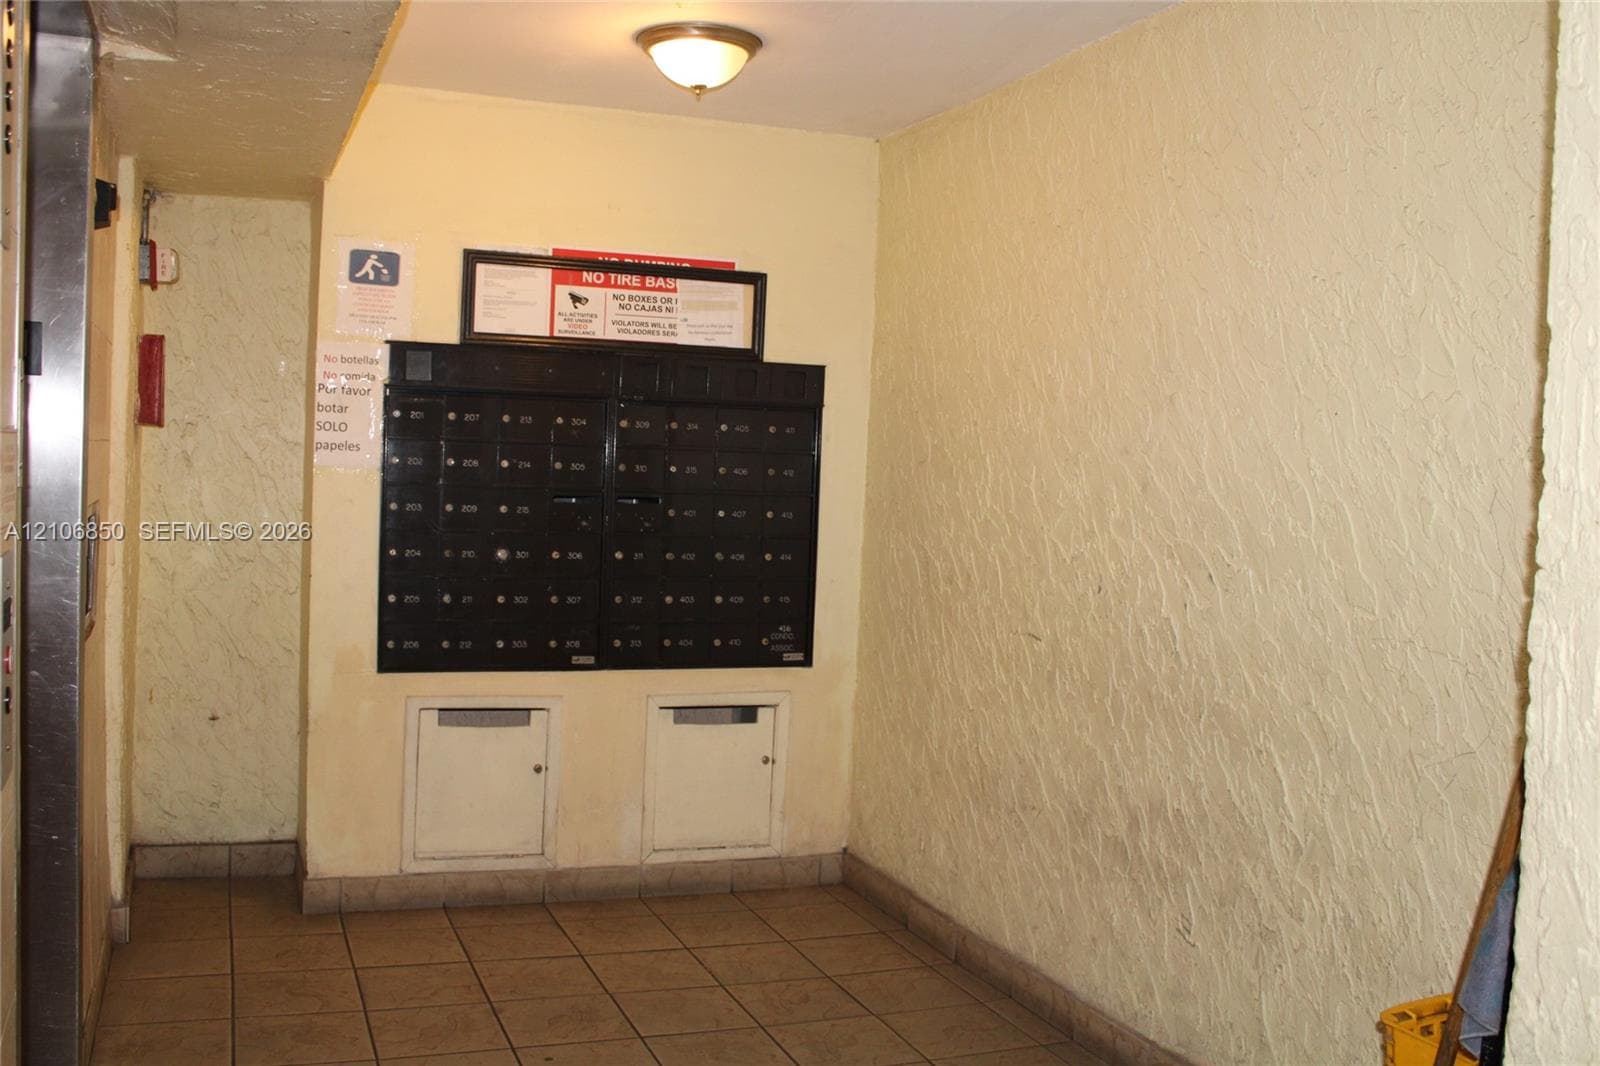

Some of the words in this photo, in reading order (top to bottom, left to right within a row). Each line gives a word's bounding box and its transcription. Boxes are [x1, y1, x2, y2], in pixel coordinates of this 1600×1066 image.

[582, 271, 604, 284] NO
[608, 273, 641, 286] TIRE
[628, 294, 657, 304] BOXES
[634, 304, 662, 312] CAJAS
[611, 320, 649, 328] VIOLATORS
[617, 328, 660, 336] VIOLADORES
[324, 354, 337, 363] No
[340, 355, 380, 365] botellas
[323, 371, 337, 379] No
[341, 385, 371, 396] favor
[317, 402, 349, 413] botar
[409, 410, 425, 420] 201
[463, 413, 480, 422] 207
[519, 415, 533, 424] 213
[570, 417, 587, 426] 304
[634, 420, 651, 429] 309
[316, 421, 348, 432] SOLO
[686, 423, 699, 431] 314
[315, 441, 360, 452] papeles
[407, 456, 423, 466] 202
[462, 459, 479, 468] 208
[633, 464, 648, 473] 310
[732, 468, 748, 476] 406
[405, 503, 423, 512] 203
[461, 504, 478, 513] 209
[516, 505, 530, 514] 215
[682, 509, 697, 518] 401
[731, 510, 747, 518] 407
[404, 549, 422, 558] 204
[461, 550, 476, 558] 210
[515, 550, 529, 559] 301
[567, 551, 583, 560] 306
[633, 552, 644, 560] 311
[779, 553, 792, 561] 414
[402, 640, 420, 649] 206
[459, 640, 473, 649] 212
[511, 640, 528, 649] 303
[564, 640, 581, 649] 308
[629, 639, 642, 648] 313
[677, 639, 693, 647] 404
[728, 638, 742, 646] 410
